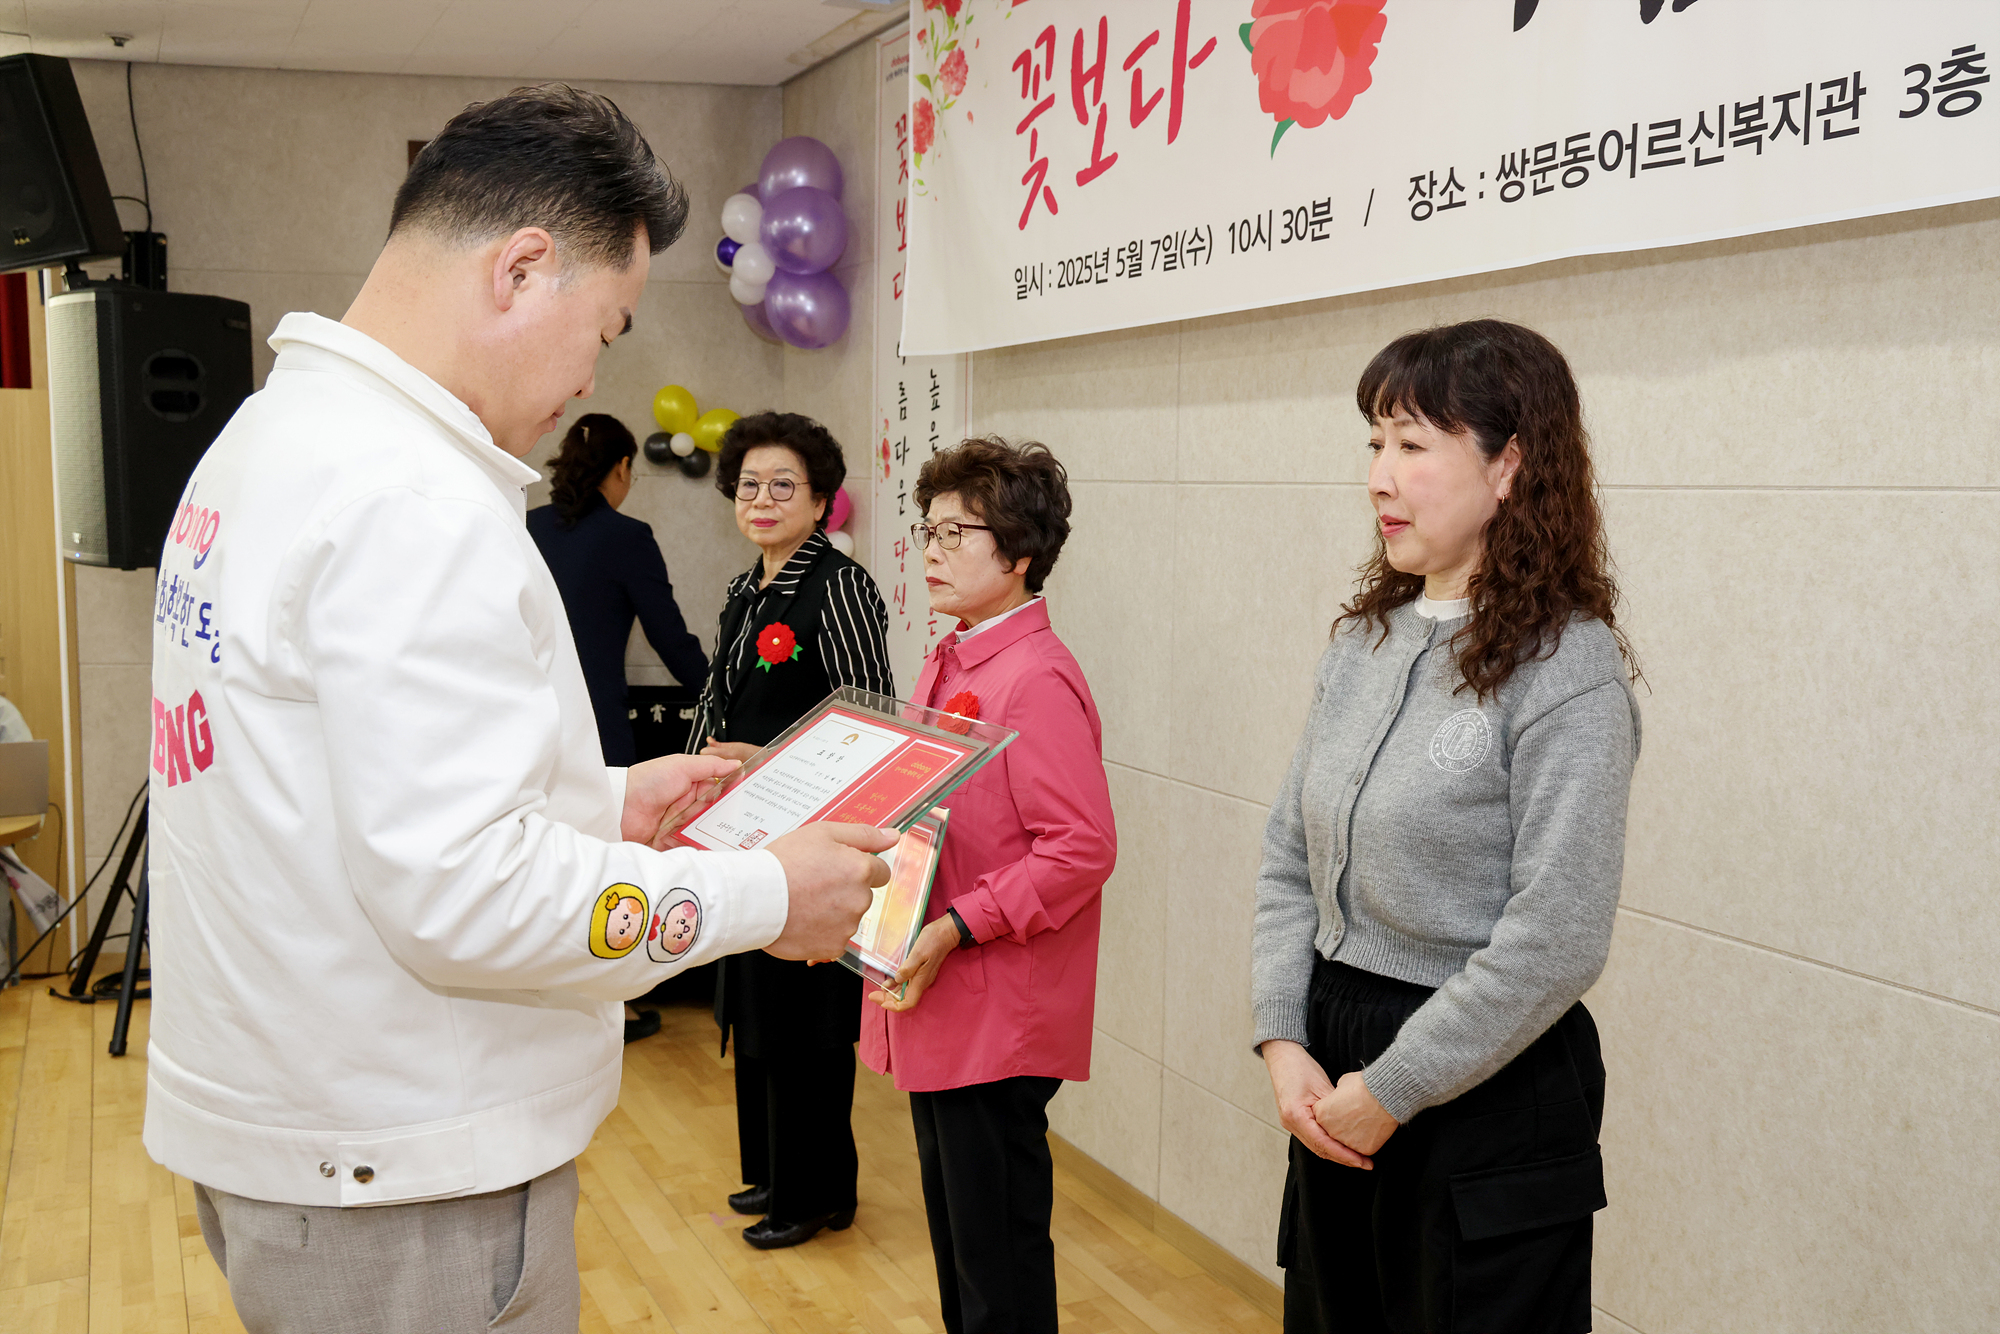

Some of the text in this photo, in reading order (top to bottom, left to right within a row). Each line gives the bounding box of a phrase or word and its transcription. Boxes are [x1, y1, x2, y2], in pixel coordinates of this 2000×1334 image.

[1012, 0, 1217, 230] 꽃보다
[1015, 263, 1043, 300] 일시
[1057, 247, 1110, 289] 2025년
[1115, 239, 1144, 279] 5월
[1150, 224, 1213, 271] 7일(수)
[1228, 209, 1273, 255] 10시
[1280, 196, 1333, 244] 30분
[1407, 166, 1467, 222] 장소
[1495, 70, 1867, 203] 쌍문동어르신복지관
[1898, 43, 1991, 119] 3층
